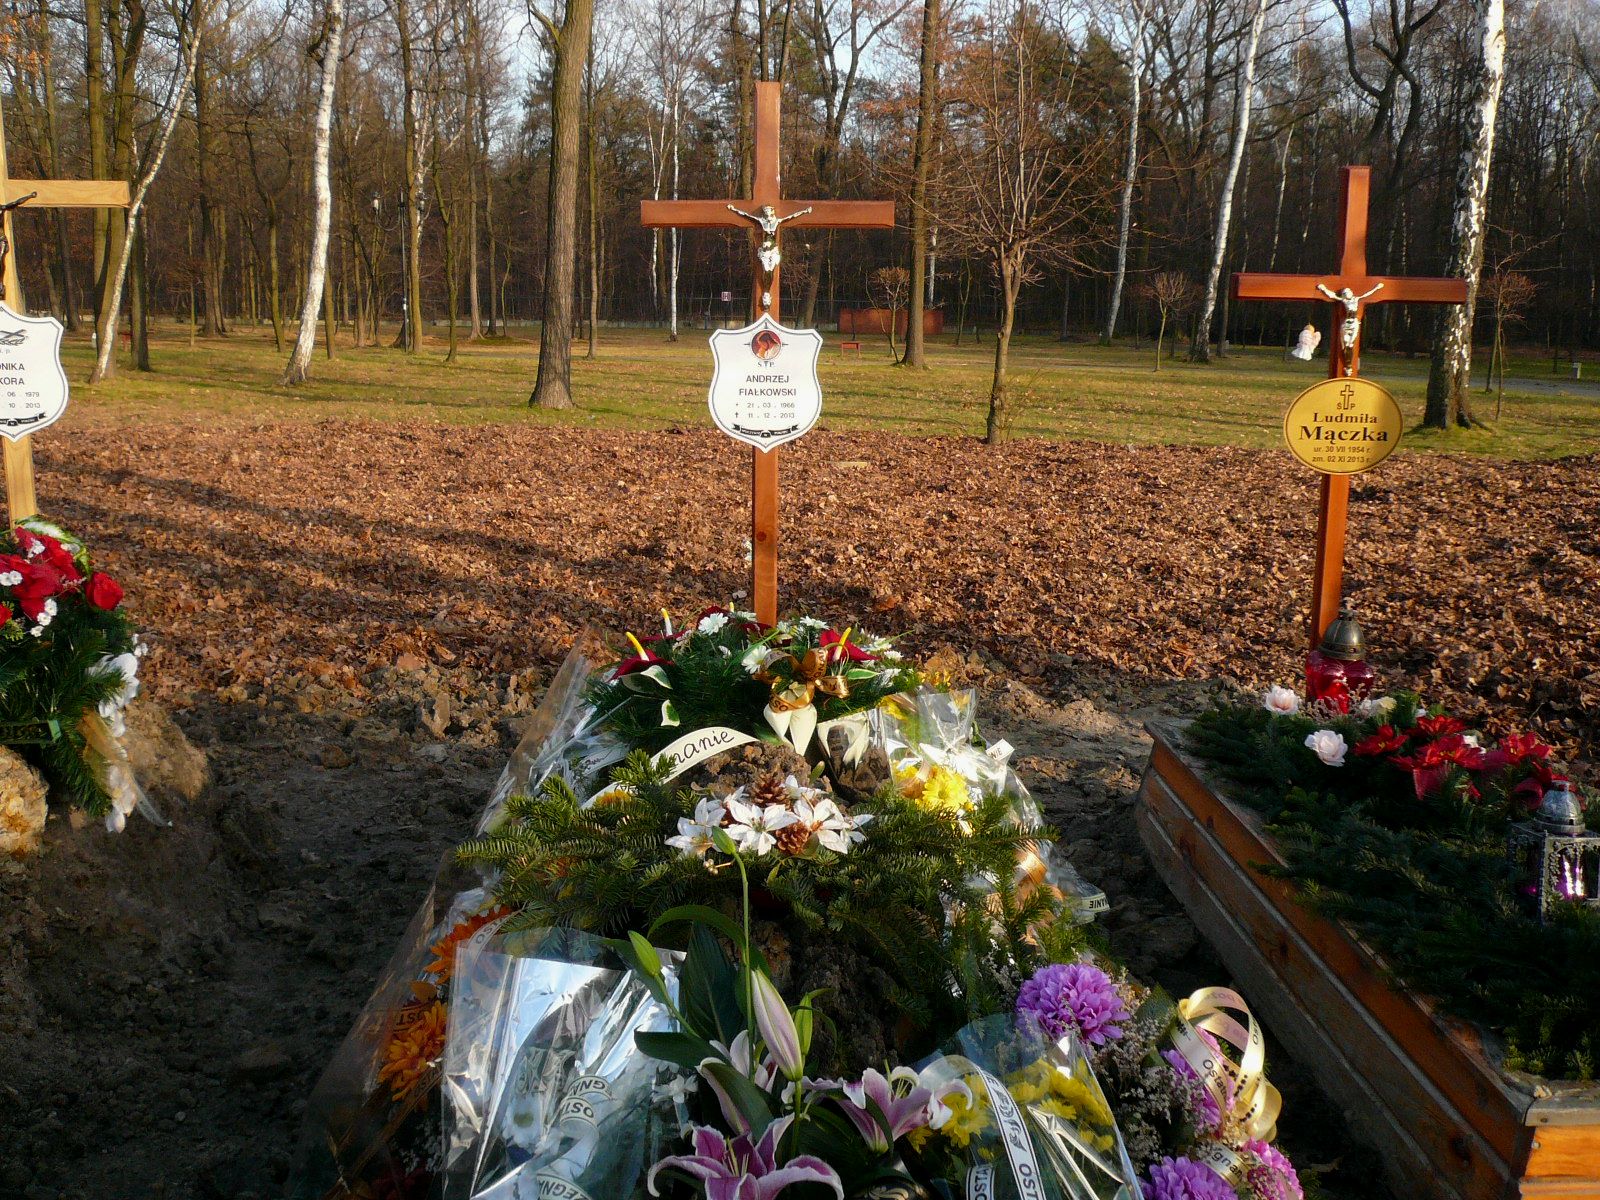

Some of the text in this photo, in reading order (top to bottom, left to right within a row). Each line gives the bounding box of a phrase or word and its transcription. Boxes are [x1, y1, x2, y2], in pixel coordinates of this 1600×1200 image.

[0, 362, 25, 370] NIKA
[745, 375, 789, 383] ANDRZEJ
[738, 388, 797, 396] FIAŁKOWSKI
[1313, 412, 1378, 424] Ludmiła
[1299, 425, 1388, 445] Mączka
